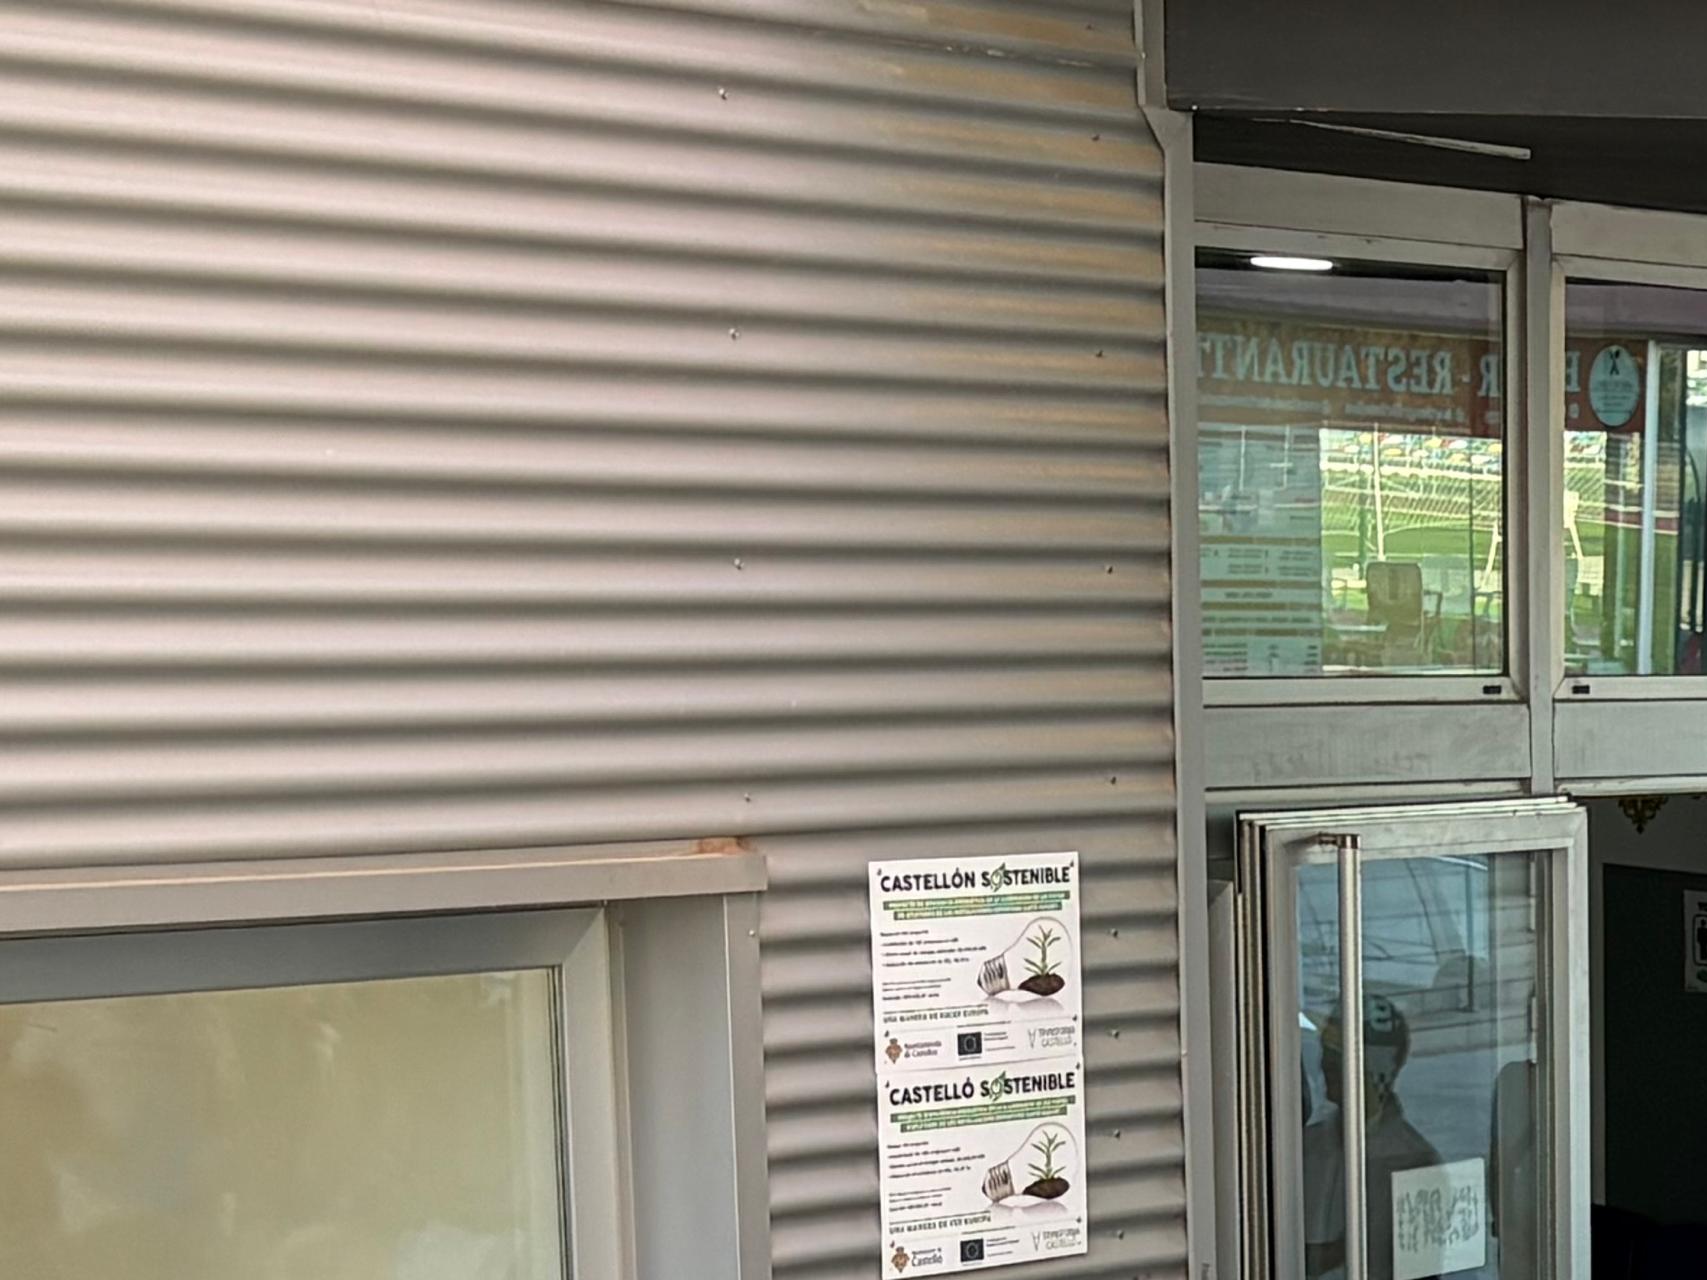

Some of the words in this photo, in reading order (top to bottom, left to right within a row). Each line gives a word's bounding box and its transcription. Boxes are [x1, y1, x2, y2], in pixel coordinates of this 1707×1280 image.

[880, 867, 975, 892] CASTELLÓN
[981, 864, 1071, 890] SOSTENIBLE
[889, 1076, 975, 1106] CASTELLÓ
[981, 1072, 1076, 1099] SOSTENIBLE
